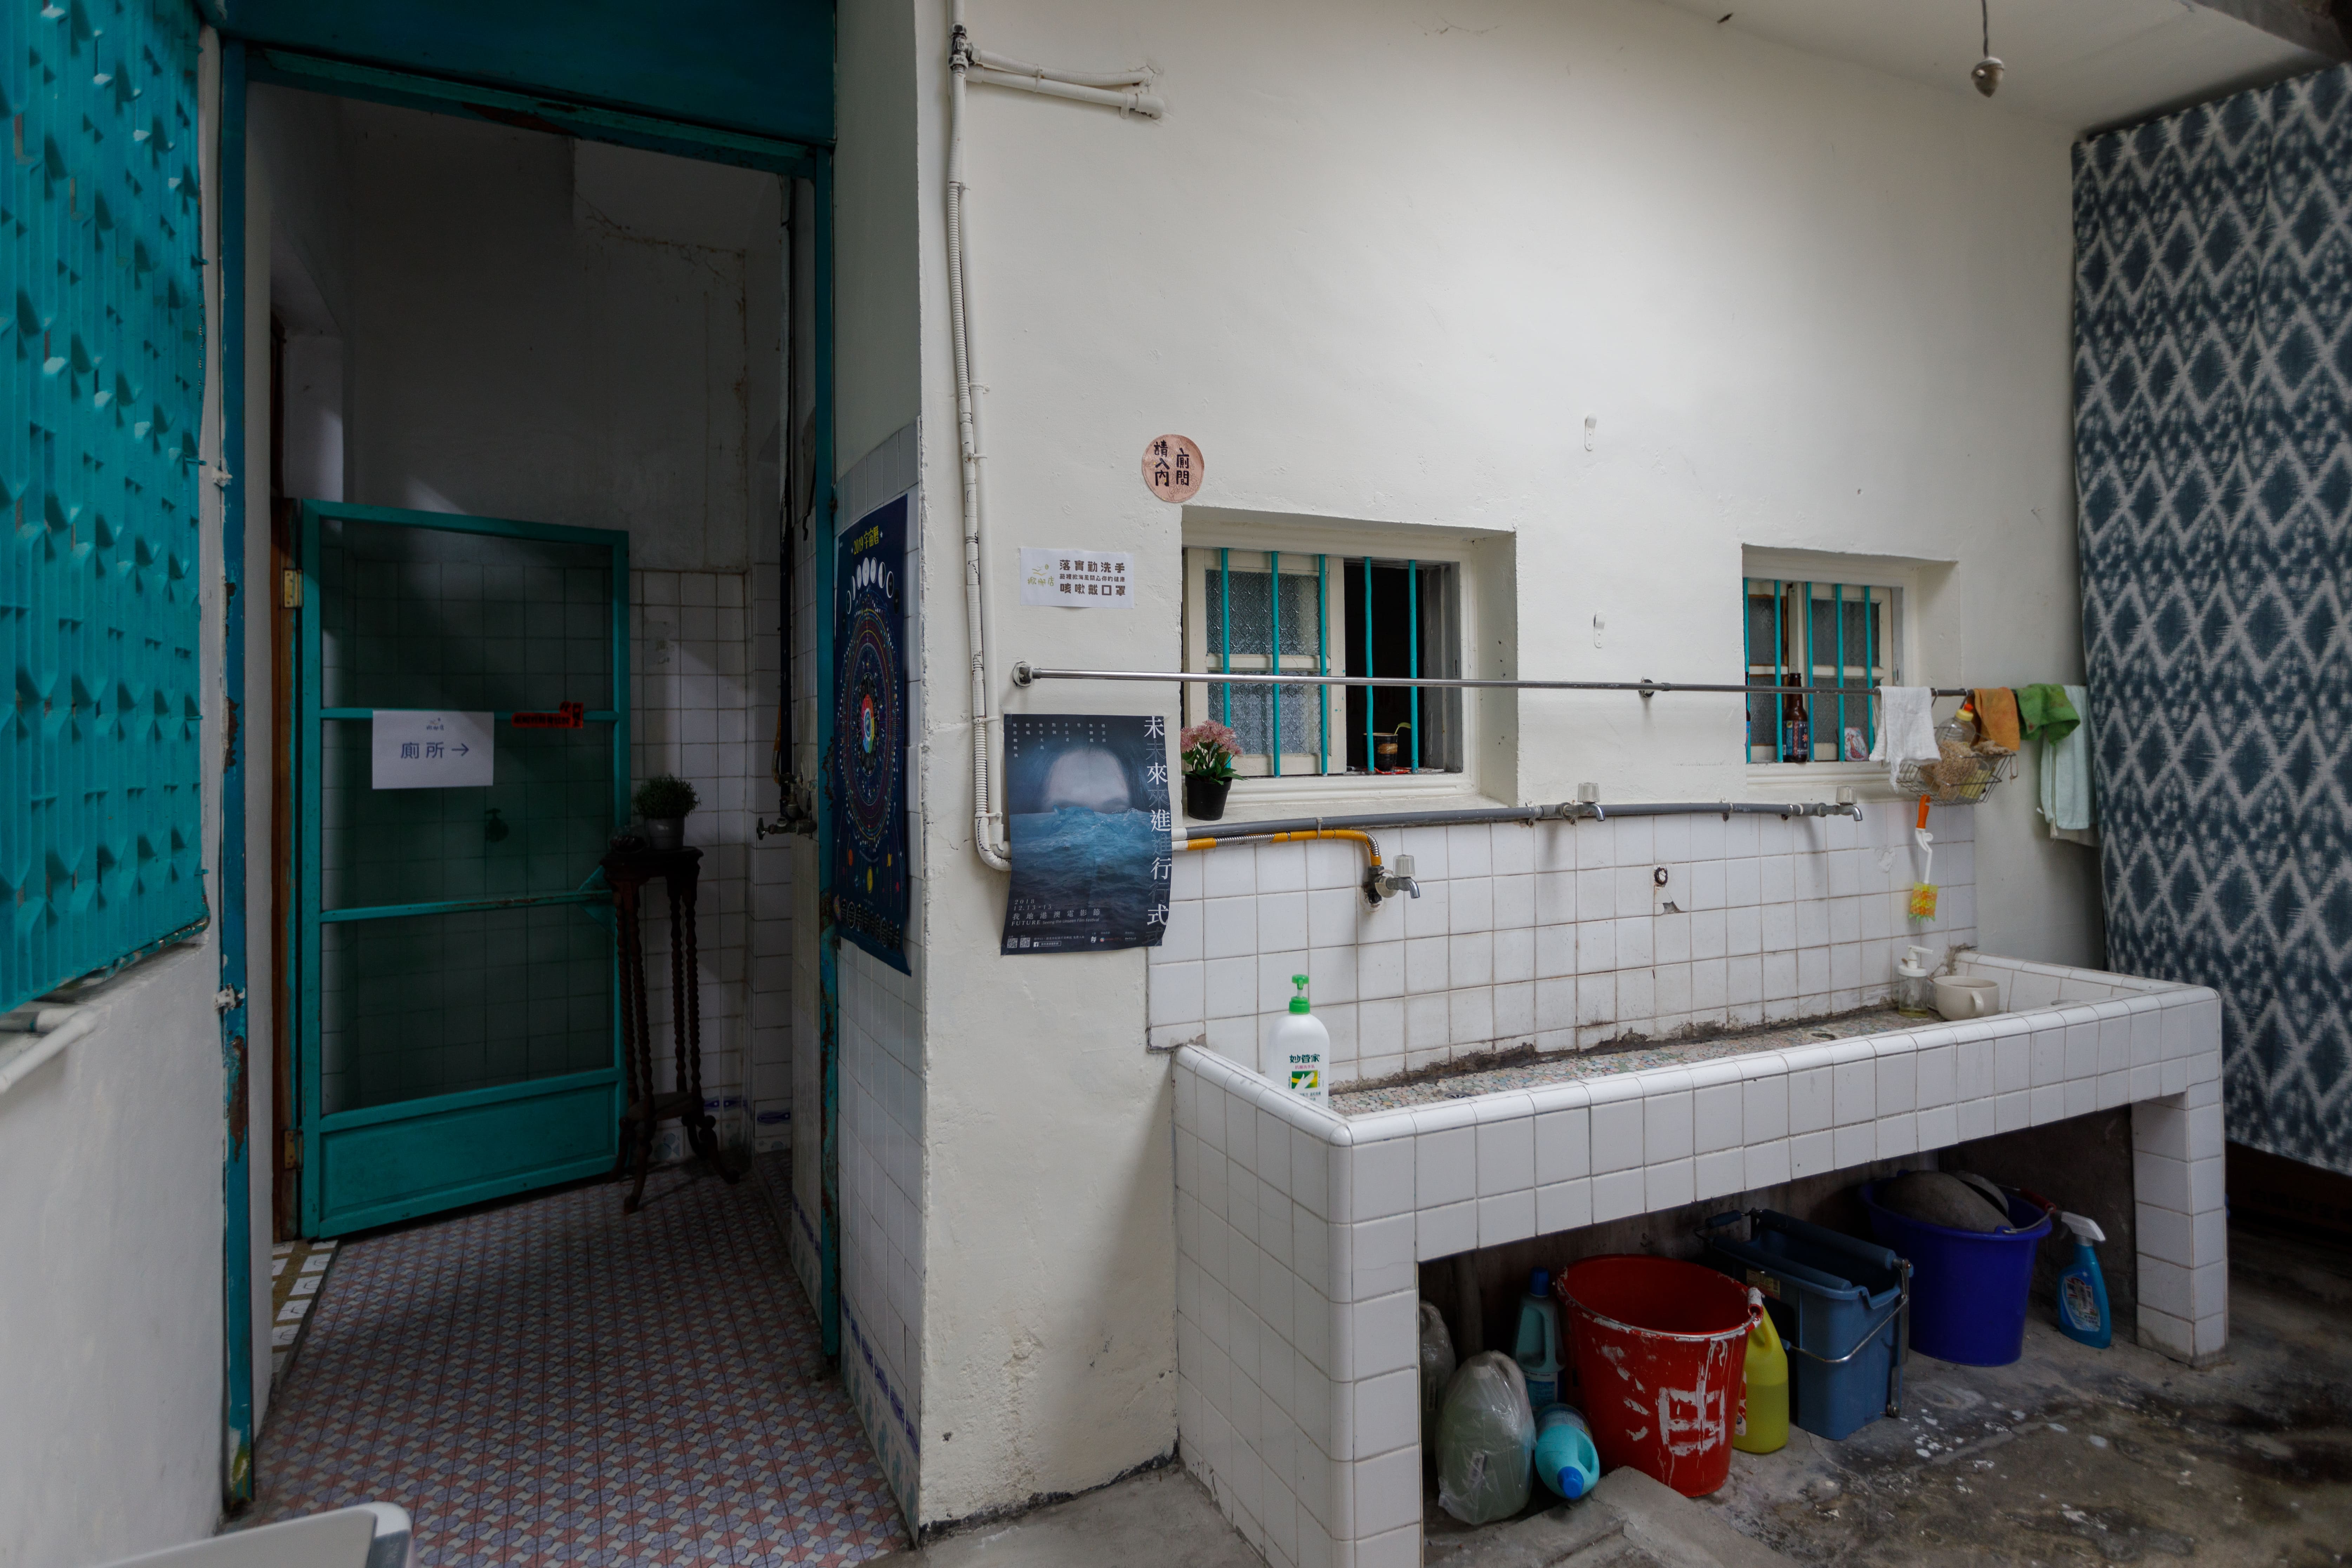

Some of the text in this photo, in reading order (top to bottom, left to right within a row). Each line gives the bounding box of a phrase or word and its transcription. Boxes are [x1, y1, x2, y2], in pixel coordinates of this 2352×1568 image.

[1154, 440, 1170, 487] 請入內
[1176, 447, 1190, 486] 廁間
[854, 525, 879, 556] 2019 宇宙曆
[1059, 559, 1125, 573] 落實勤洗手
[1060, 583, 1126, 596] 咳嗽戴口罩
[401, 741, 445, 759] 廁所
[1012, 908, 1101, 921] 我地港澳電影節
[1289, 1054, 1320, 1063] 妙管家
